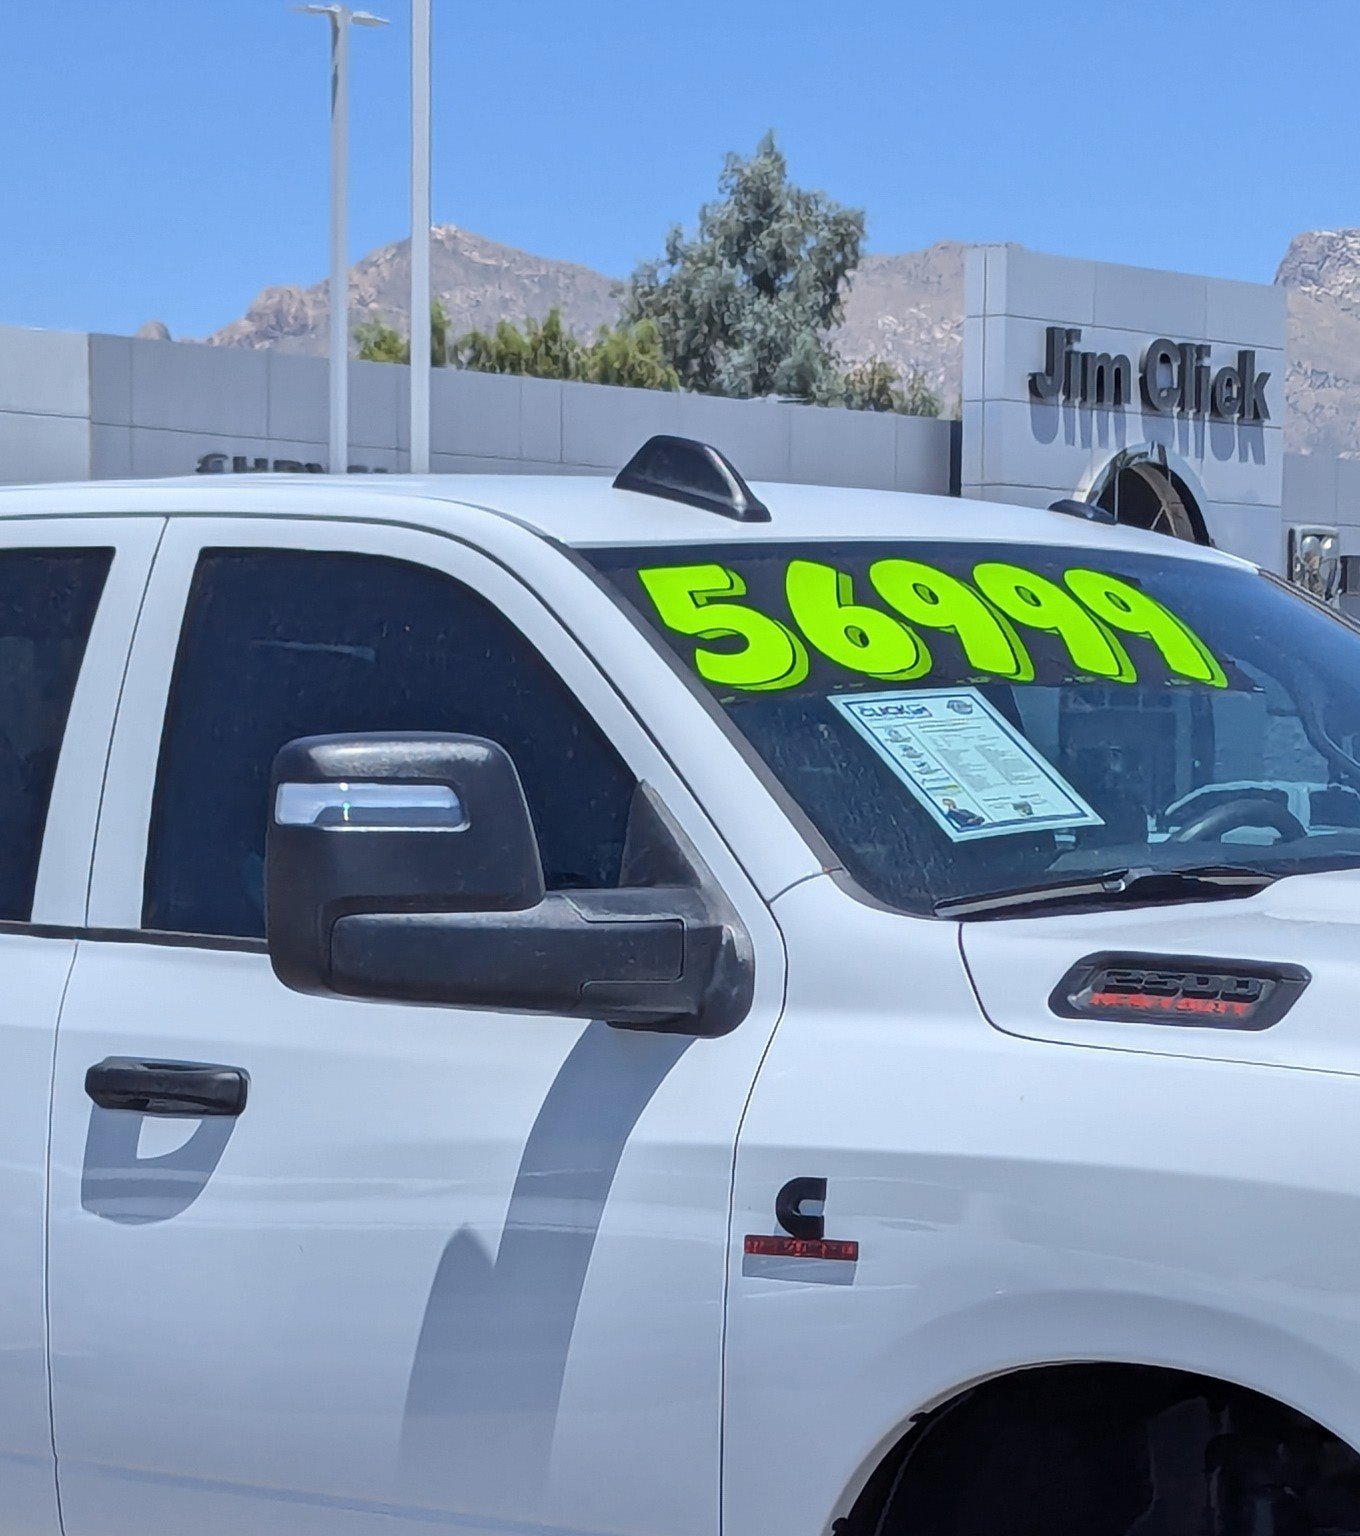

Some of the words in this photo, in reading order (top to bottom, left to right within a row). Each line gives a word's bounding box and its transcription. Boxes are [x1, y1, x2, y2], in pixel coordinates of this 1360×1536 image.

[1028, 326, 1131, 404] Jim
[1139, 338, 1271, 421] Click
[638, 558, 1229, 692] 56999
